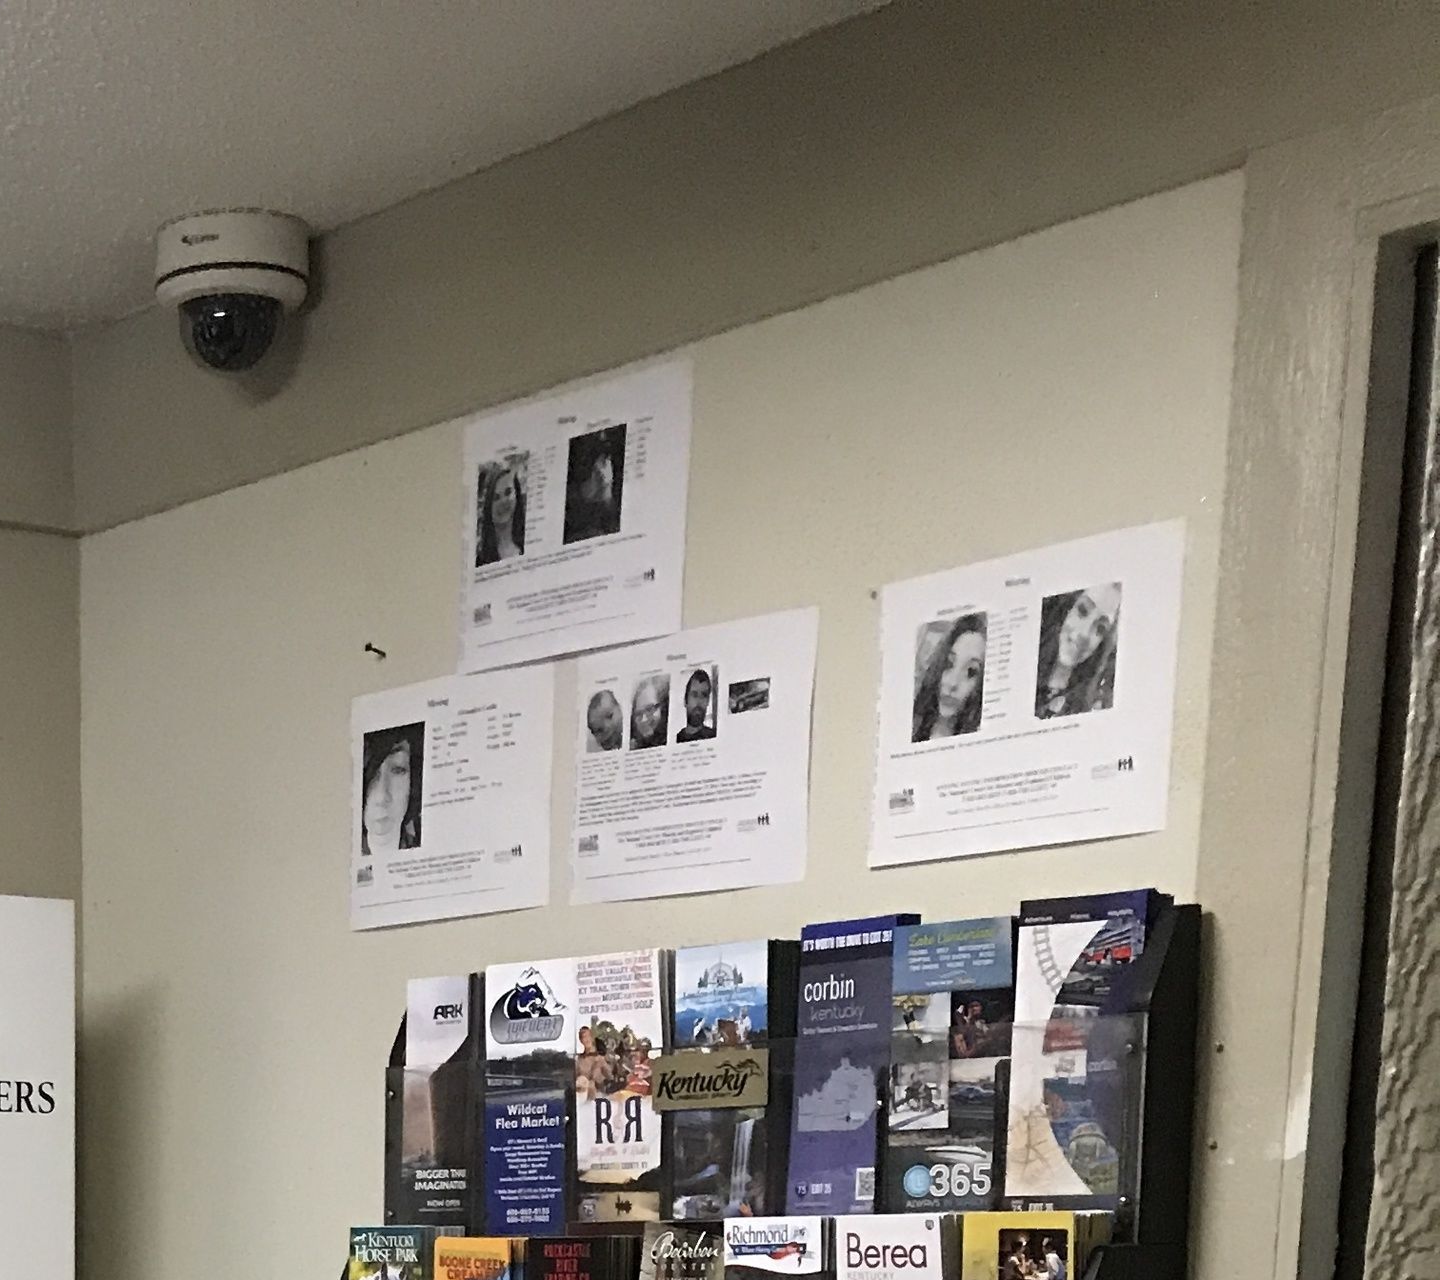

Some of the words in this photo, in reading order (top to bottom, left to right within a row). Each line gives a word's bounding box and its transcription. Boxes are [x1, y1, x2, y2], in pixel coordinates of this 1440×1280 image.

[804, 974, 855, 1002] corbin
[433, 1004, 463, 1020] ARK
[810, 1003, 865, 1021] kentucky
[657, 1069, 748, 1100] Kentucky
[507, 1104, 547, 1115] Wildcat
[496, 1118, 518, 1129] Flea
[521, 1116, 560, 1128] Market
[415, 1169, 449, 1181] BIGGER
[929, 1163, 992, 1197] 365
[368, 1233, 415, 1247] KENTUCKY
[732, 1224, 788, 1244] Richmond
[355, 1245, 393, 1262] HORSE
[395, 1247, 420, 1262] PARK
[846, 1232, 928, 1269] Berea
[440, 1255, 472, 1269] BOONE
[474, 1258, 506, 1271] CREEK
[846, 1271, 894, 1280] KENTUCKY
